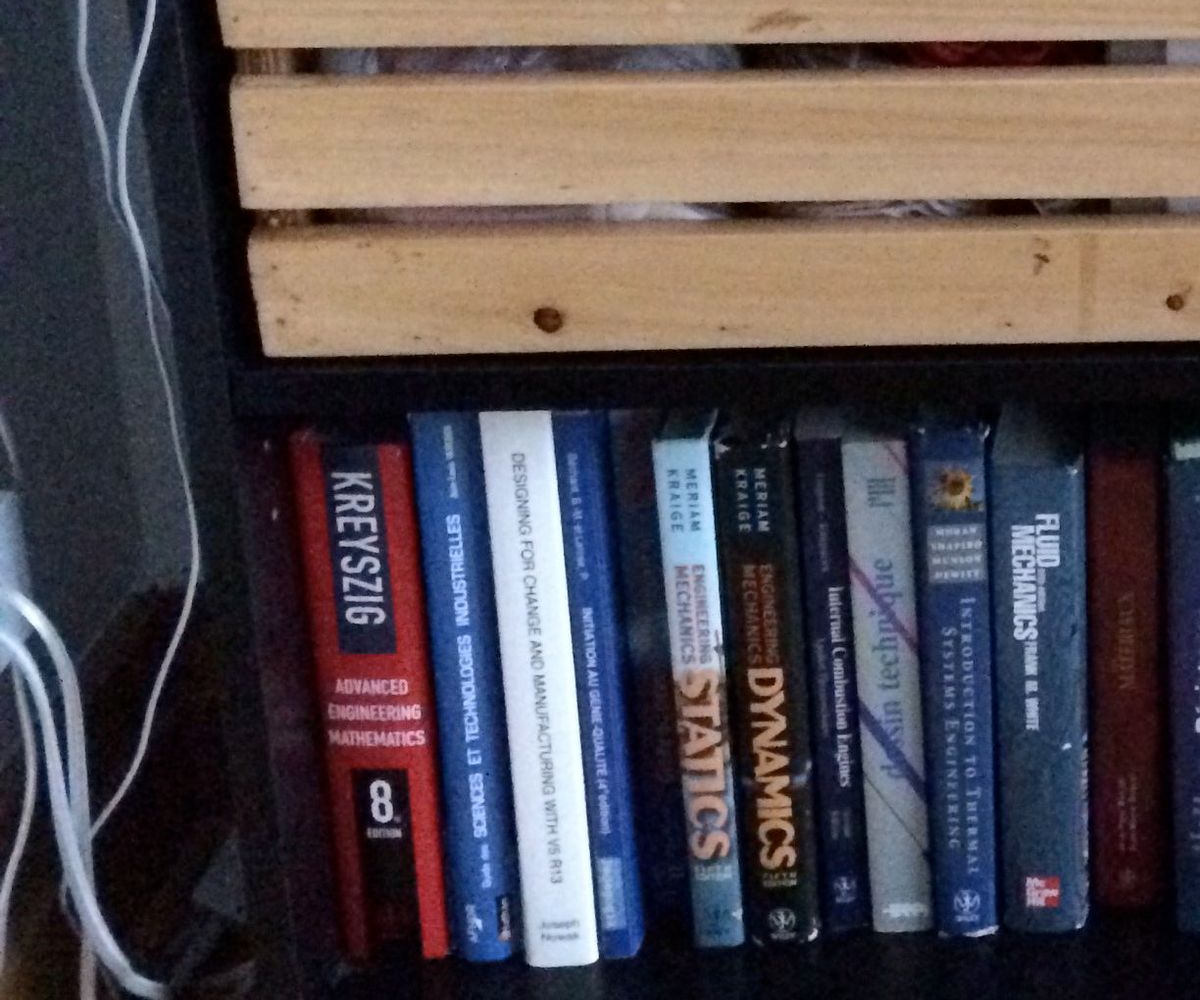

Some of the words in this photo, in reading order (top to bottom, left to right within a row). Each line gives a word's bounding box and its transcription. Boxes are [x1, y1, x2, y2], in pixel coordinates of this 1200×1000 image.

[511, 452, 533, 536] DESIGNING
[667, 468, 684, 533] KRAIGE
[684, 468, 702, 532] MERIAM
[735, 468, 752, 533] KRAIGE
[753, 467, 771, 532] MERIAM
[331, 471, 386, 626] KREYSZIG
[446, 513, 469, 627] INDUSTRIELLES
[519, 539, 535, 571] FOR
[1035, 513, 1061, 568] FLUID
[523, 574, 542, 636] CHANGE
[674, 565, 695, 665] MECHANICS
[692, 564, 712, 664] ENGINEERING
[742, 564, 762, 665] MECHANICS
[760, 564, 780, 665] ENGINEERING
[827, 586, 846, 642] Internal
[1011, 524, 1038, 641] MECHANICS
[529, 640, 546, 671] AND
[582, 607, 598, 667] INITIATION
[941, 626, 958, 710] SYSTEMS
[335, 678, 409, 697] ADVANCED
[456, 634, 480, 743] TECHNOLOGIES
[586, 669, 600, 687] AU
[831, 647, 853, 730] Combustion
[960, 597, 977, 745] INTRODUCTION
[328, 703, 422, 721] ENGINEERING
[329, 730, 427, 747] MATHEMATICS
[532, 674, 556, 796] MANUFACTURING
[1024, 697, 1040, 731] WHITE
[465, 748, 483, 766] ET
[679, 668, 730, 860] STATICS
[747, 667, 797, 870] DYNAMICS
[834, 733, 855, 788] Engines
[944, 719, 962, 849] ENGINEERING
[964, 755, 978, 778] TO
[369, 779, 394, 824] 8
[467, 773, 489, 838] SCIENCES
[544, 799, 559, 836] WITH
[965, 786, 982, 875] THERMAL
[549, 859, 563, 884] R13
